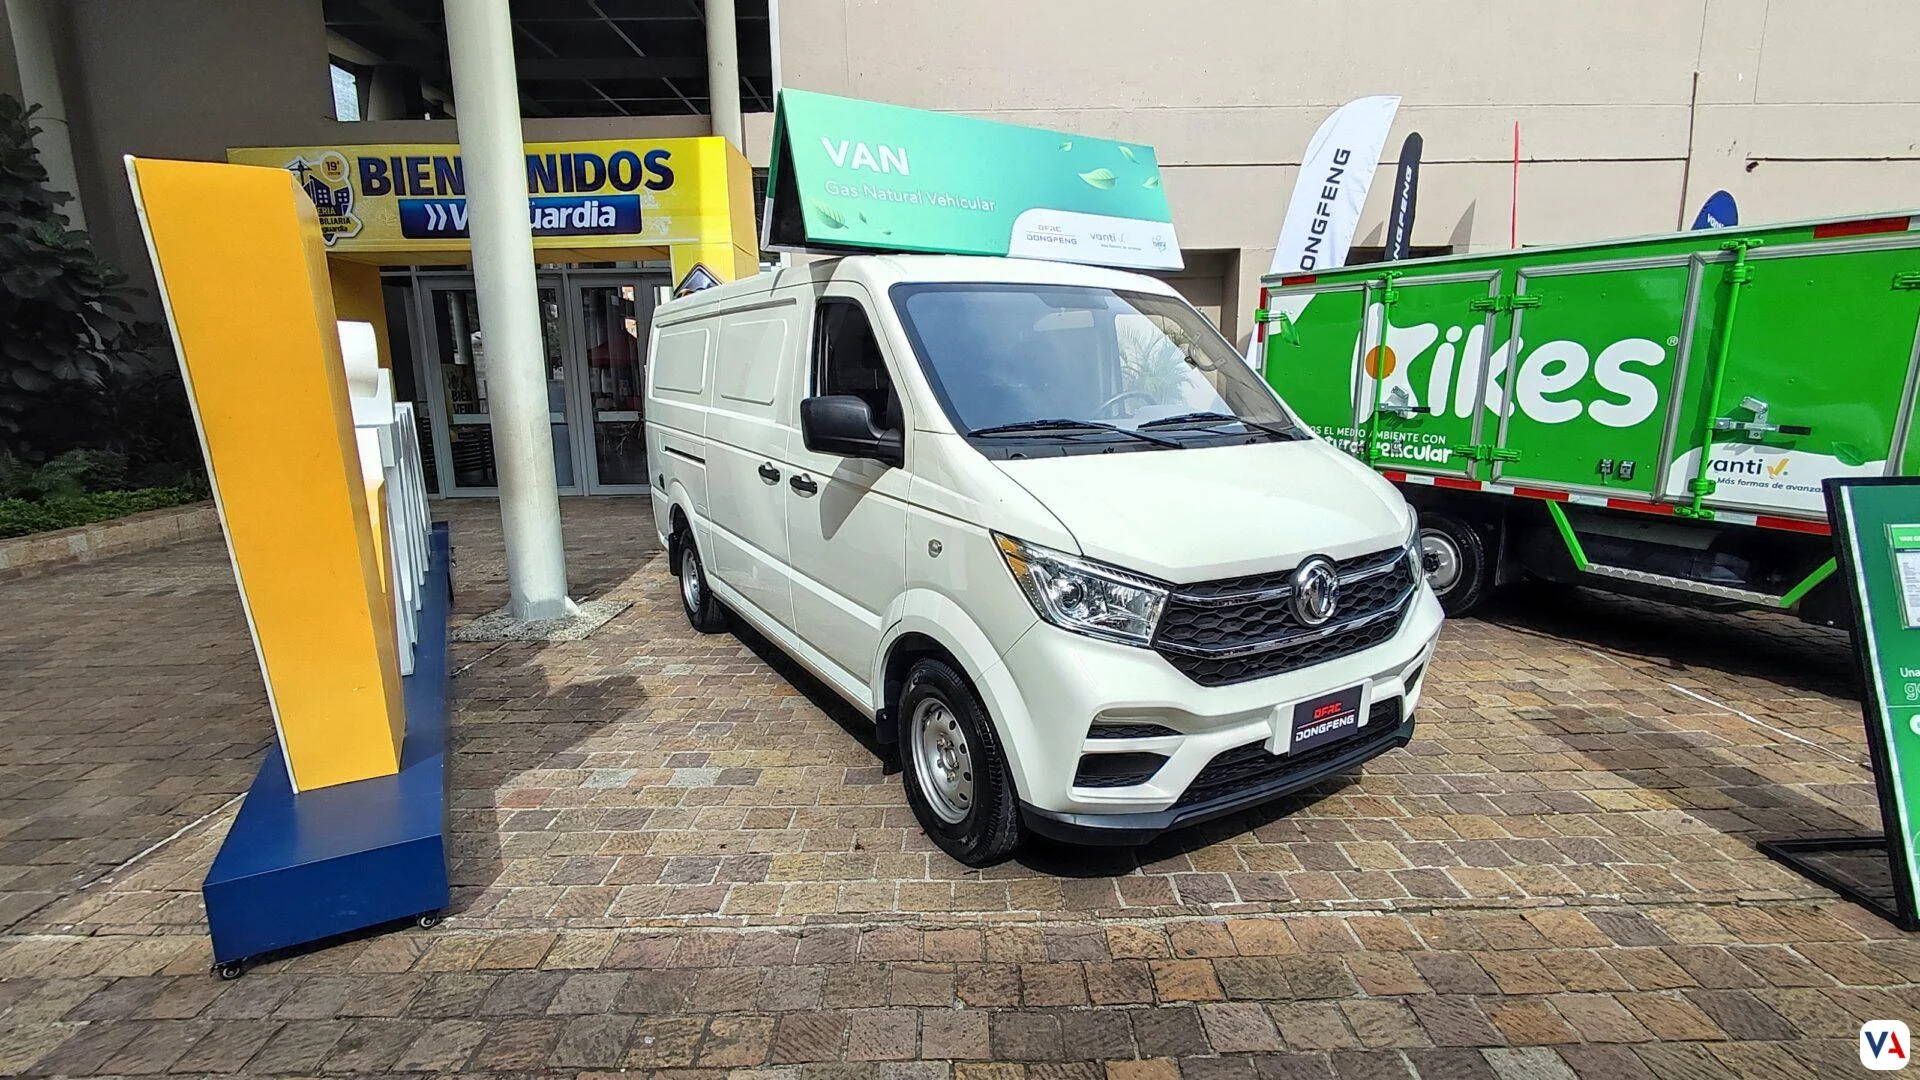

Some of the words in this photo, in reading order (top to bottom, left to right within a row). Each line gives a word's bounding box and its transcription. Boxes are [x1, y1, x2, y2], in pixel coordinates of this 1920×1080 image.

[820, 135, 910, 176] VAN
[358, 149, 674, 197] BIENNIDOS
[825, 180, 858, 198] Gas
[863, 183, 922, 205] Natural
[925, 191, 996, 212] Vehicular
[1300, 148, 1351, 271] ONGFENG
[317, 207, 336, 215] ERIA
[319, 217, 351, 225] BILIARIA
[449, 200, 616, 231] Vuardia
[1392, 165, 1412, 263] NGFENG
[1026, 234, 1077, 245] DONGFENG
[1090, 232, 1116, 242] vanti
[1350, 302, 1665, 428] Kikes
[1323, 426, 1335, 436] EL
[1336, 427, 1366, 438] MEDIO
[1422, 434, 1446, 445] CON
[1716, 476, 1735, 486] Más
[1737, 478, 1769, 488] formas
[1771, 481, 1783, 490] de
[1785, 484, 1823, 493] avanza
[1295, 714, 1355, 742] DONGFENG
